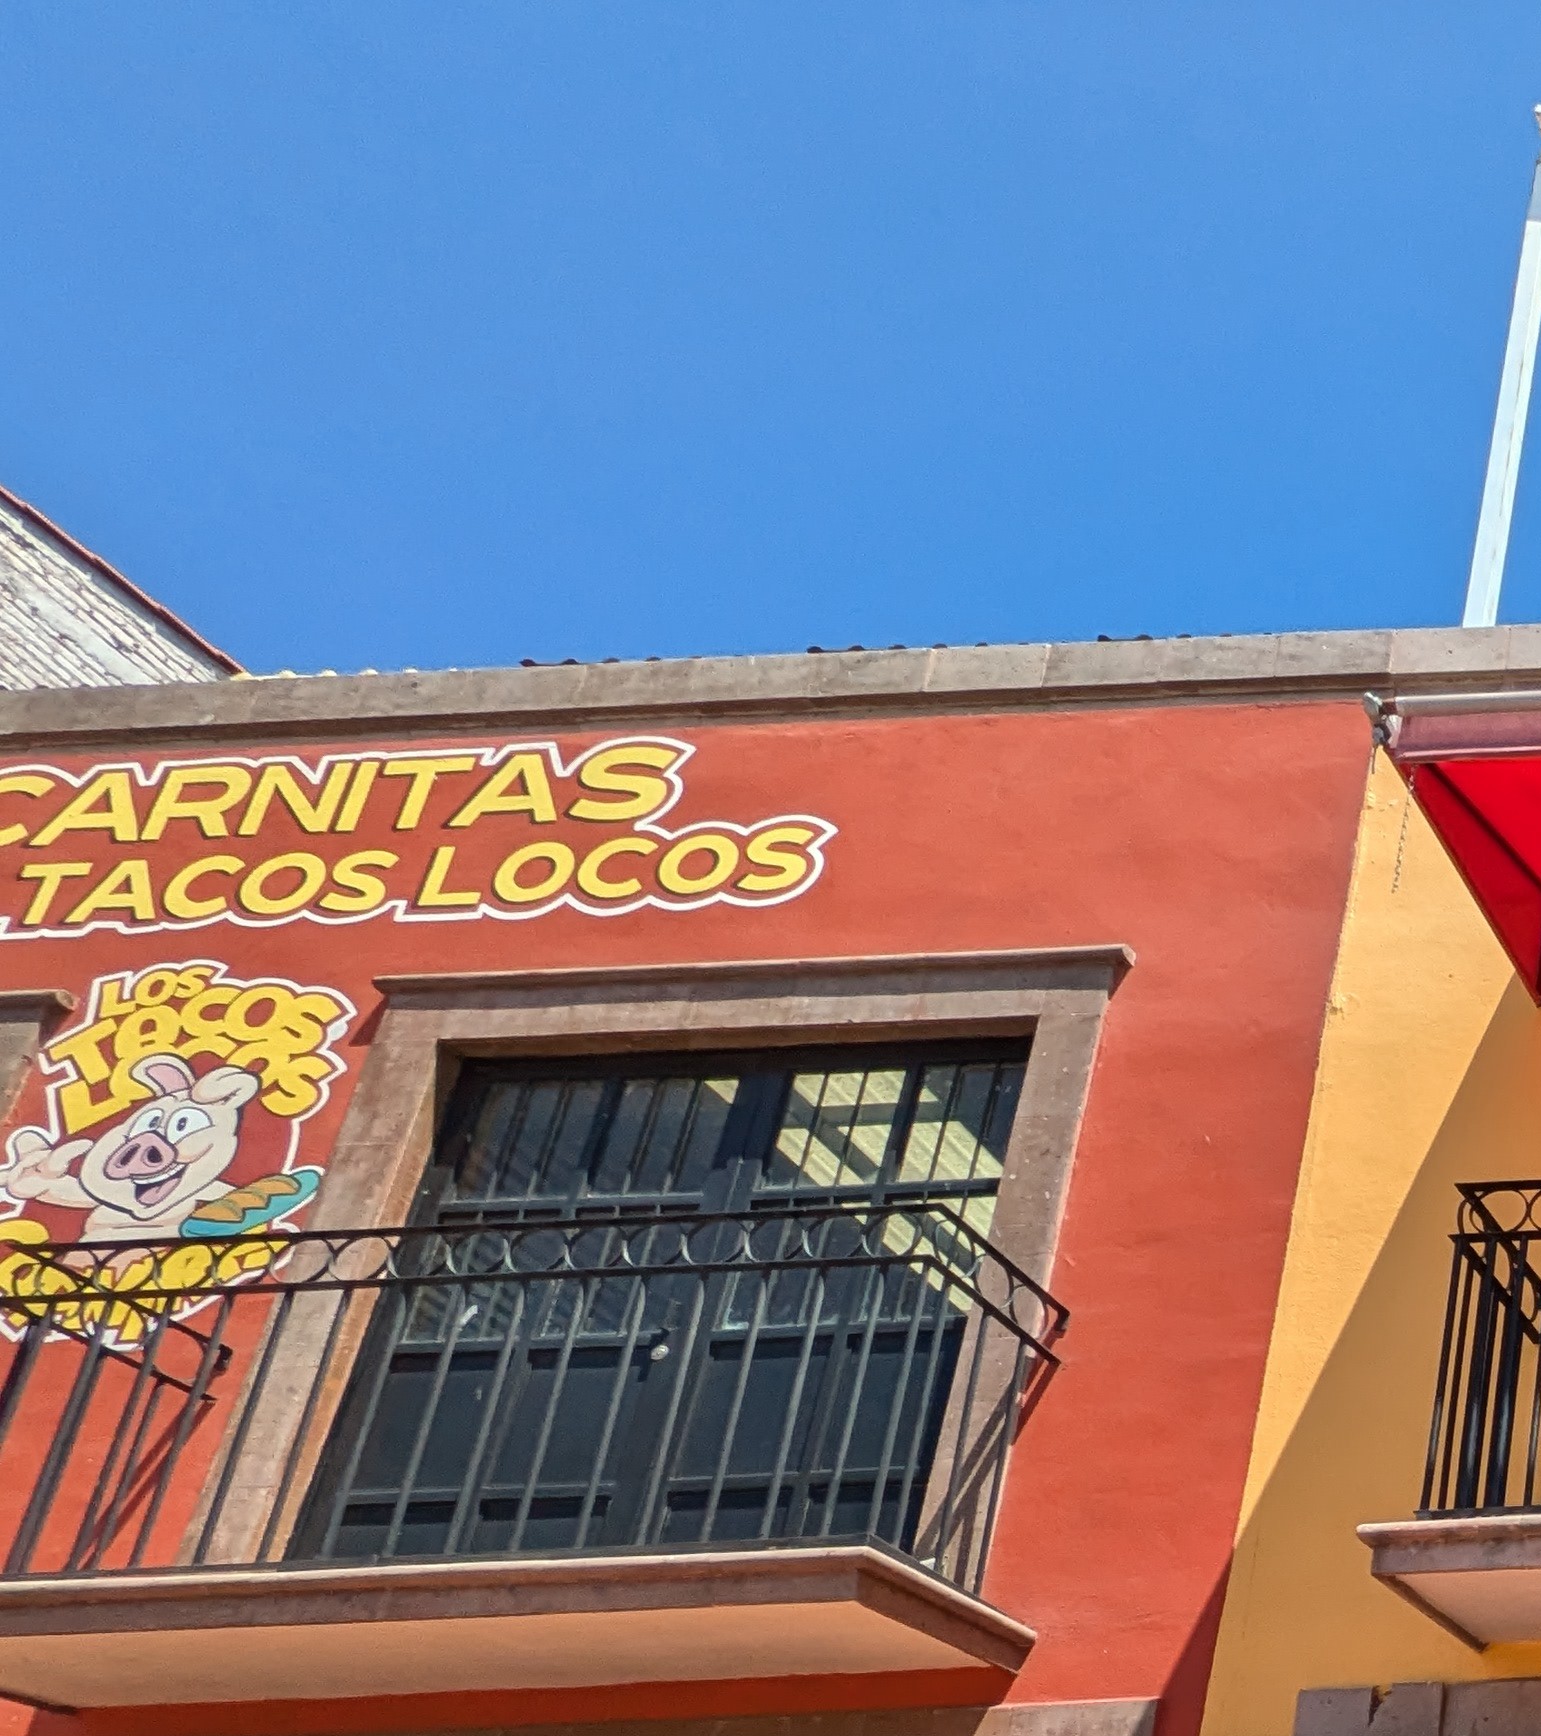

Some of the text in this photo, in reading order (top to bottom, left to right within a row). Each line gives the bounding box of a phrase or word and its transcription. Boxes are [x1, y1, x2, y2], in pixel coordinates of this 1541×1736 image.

[0, 743, 681, 847] CARNITAS
[18, 823, 819, 928] TACOS LOCOS
[99, 965, 216, 1018] LOS
